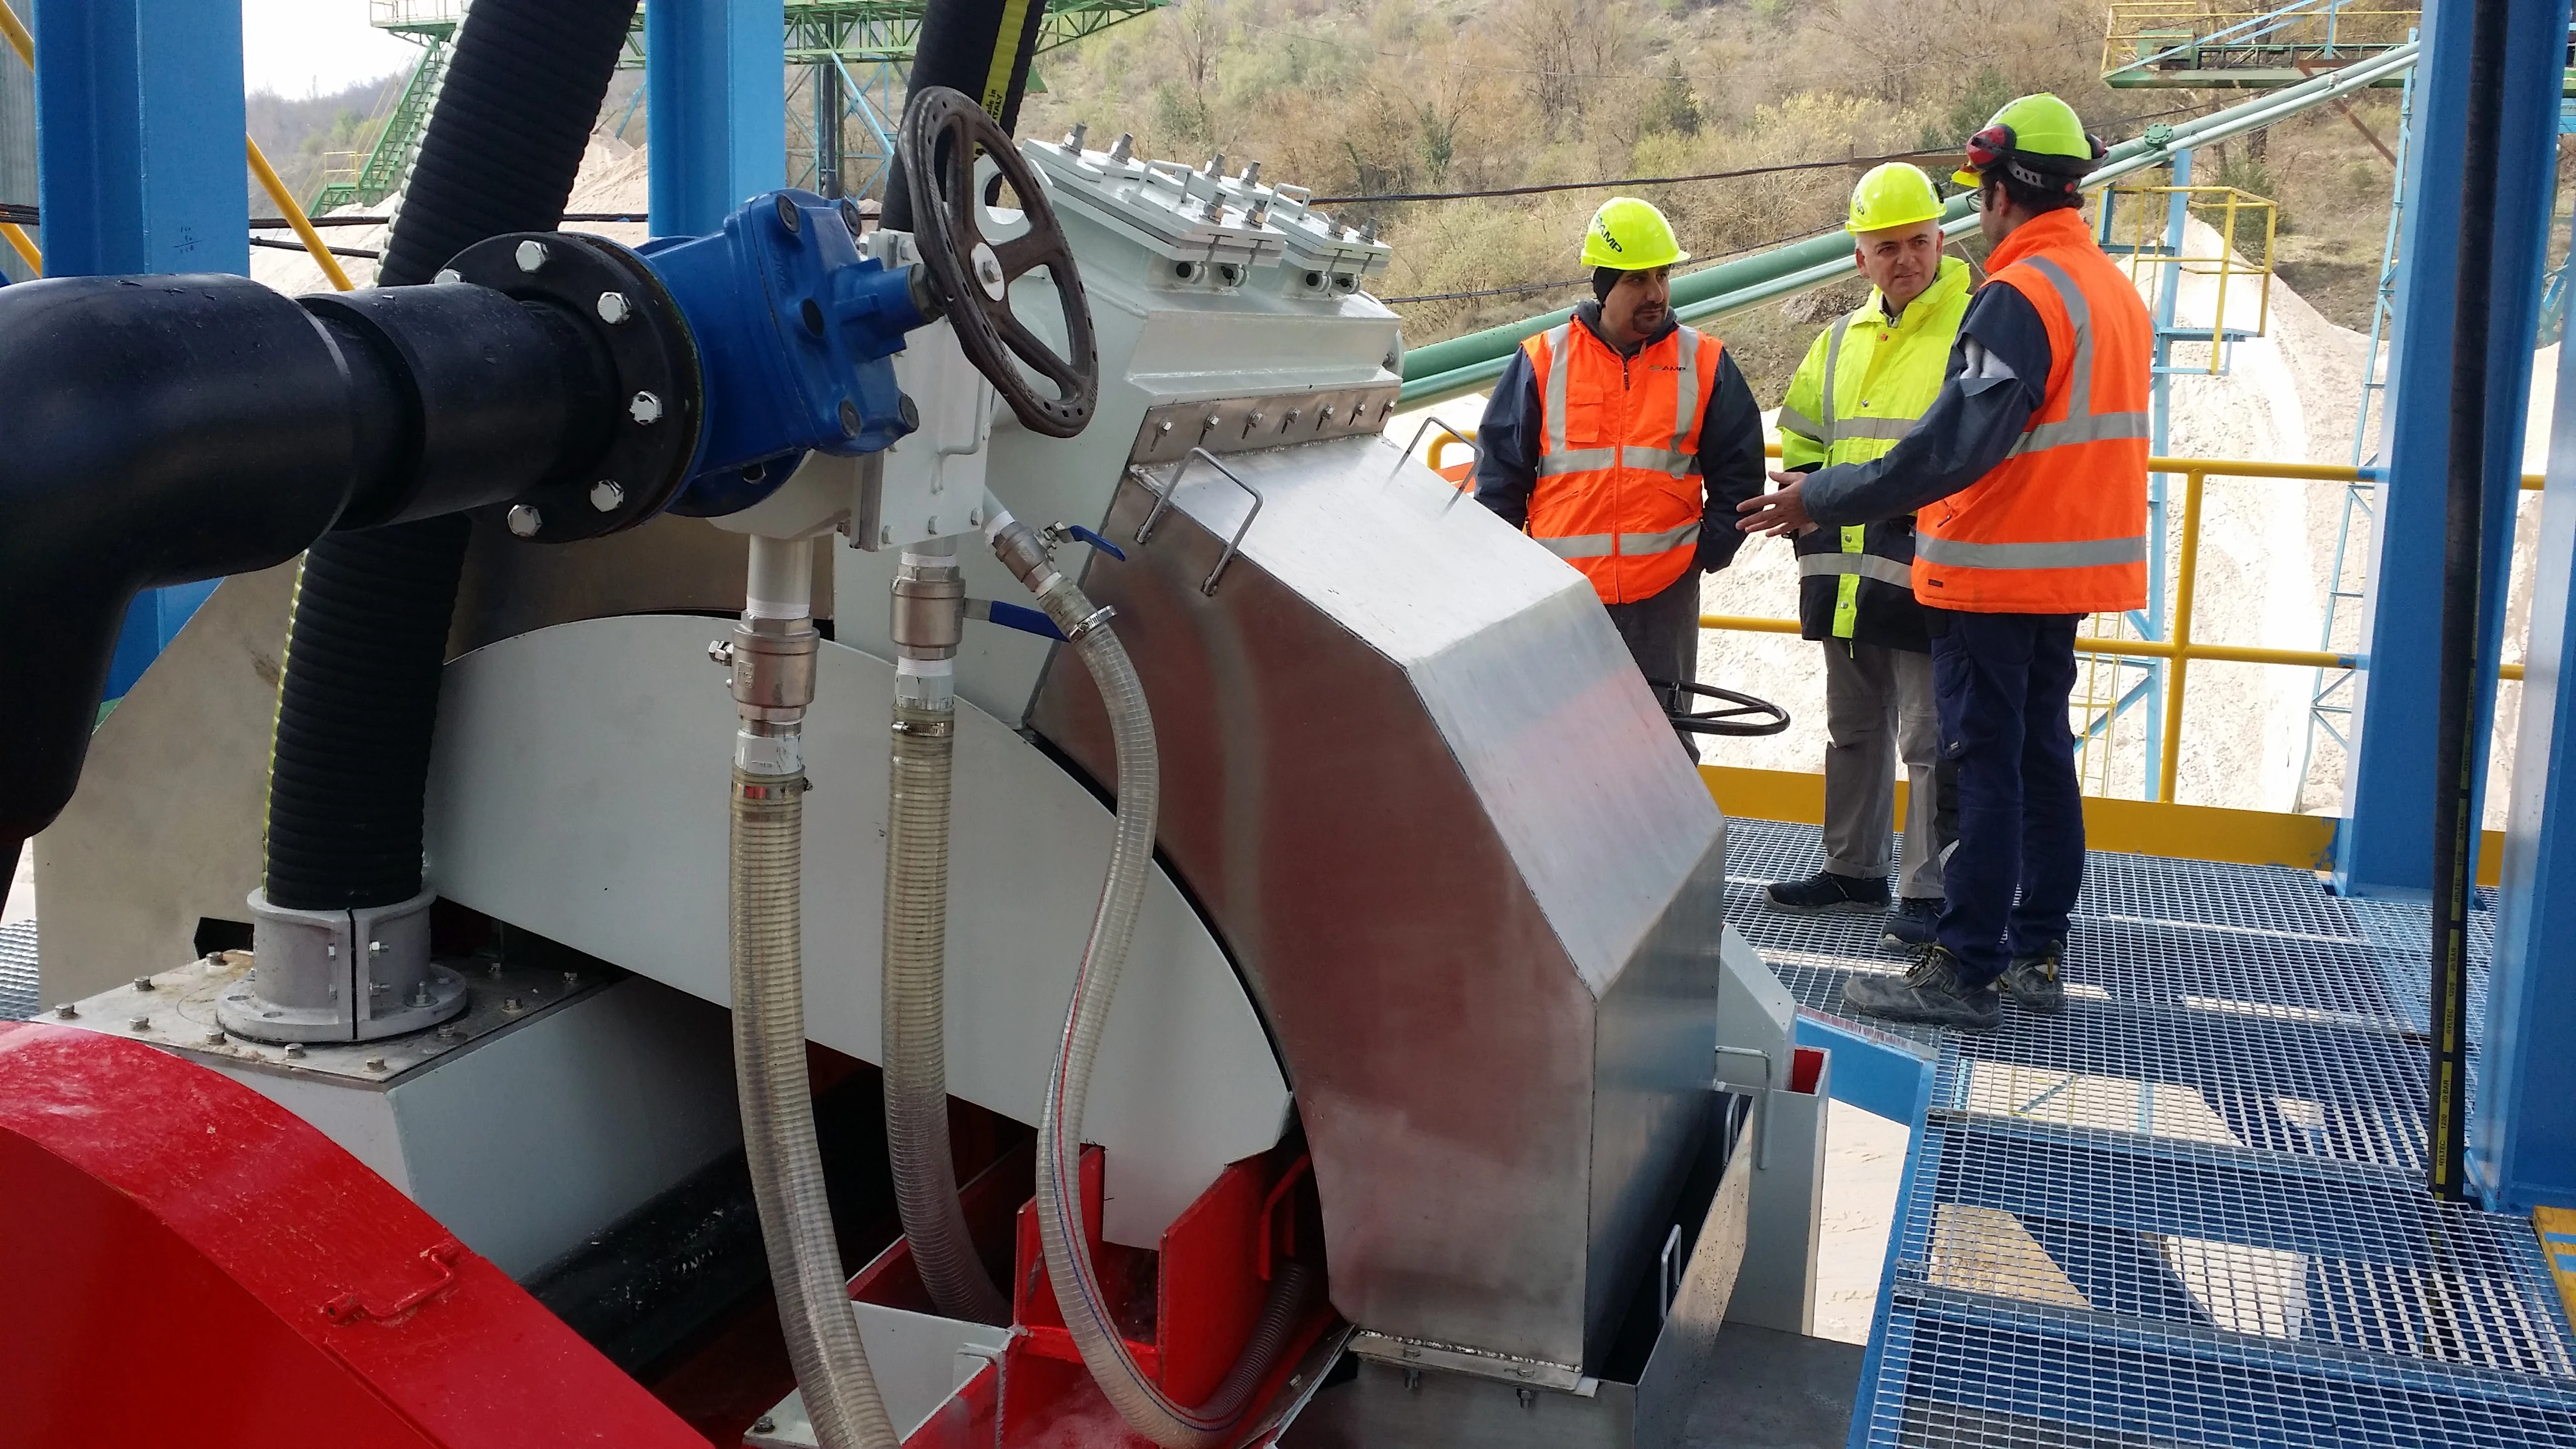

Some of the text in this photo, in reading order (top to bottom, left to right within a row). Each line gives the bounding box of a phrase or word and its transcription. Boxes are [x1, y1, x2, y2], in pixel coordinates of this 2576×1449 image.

[988, 89, 996, 97] in
[992, 94, 1002, 119] ITALY
[1598, 224, 1622, 253] AMP
